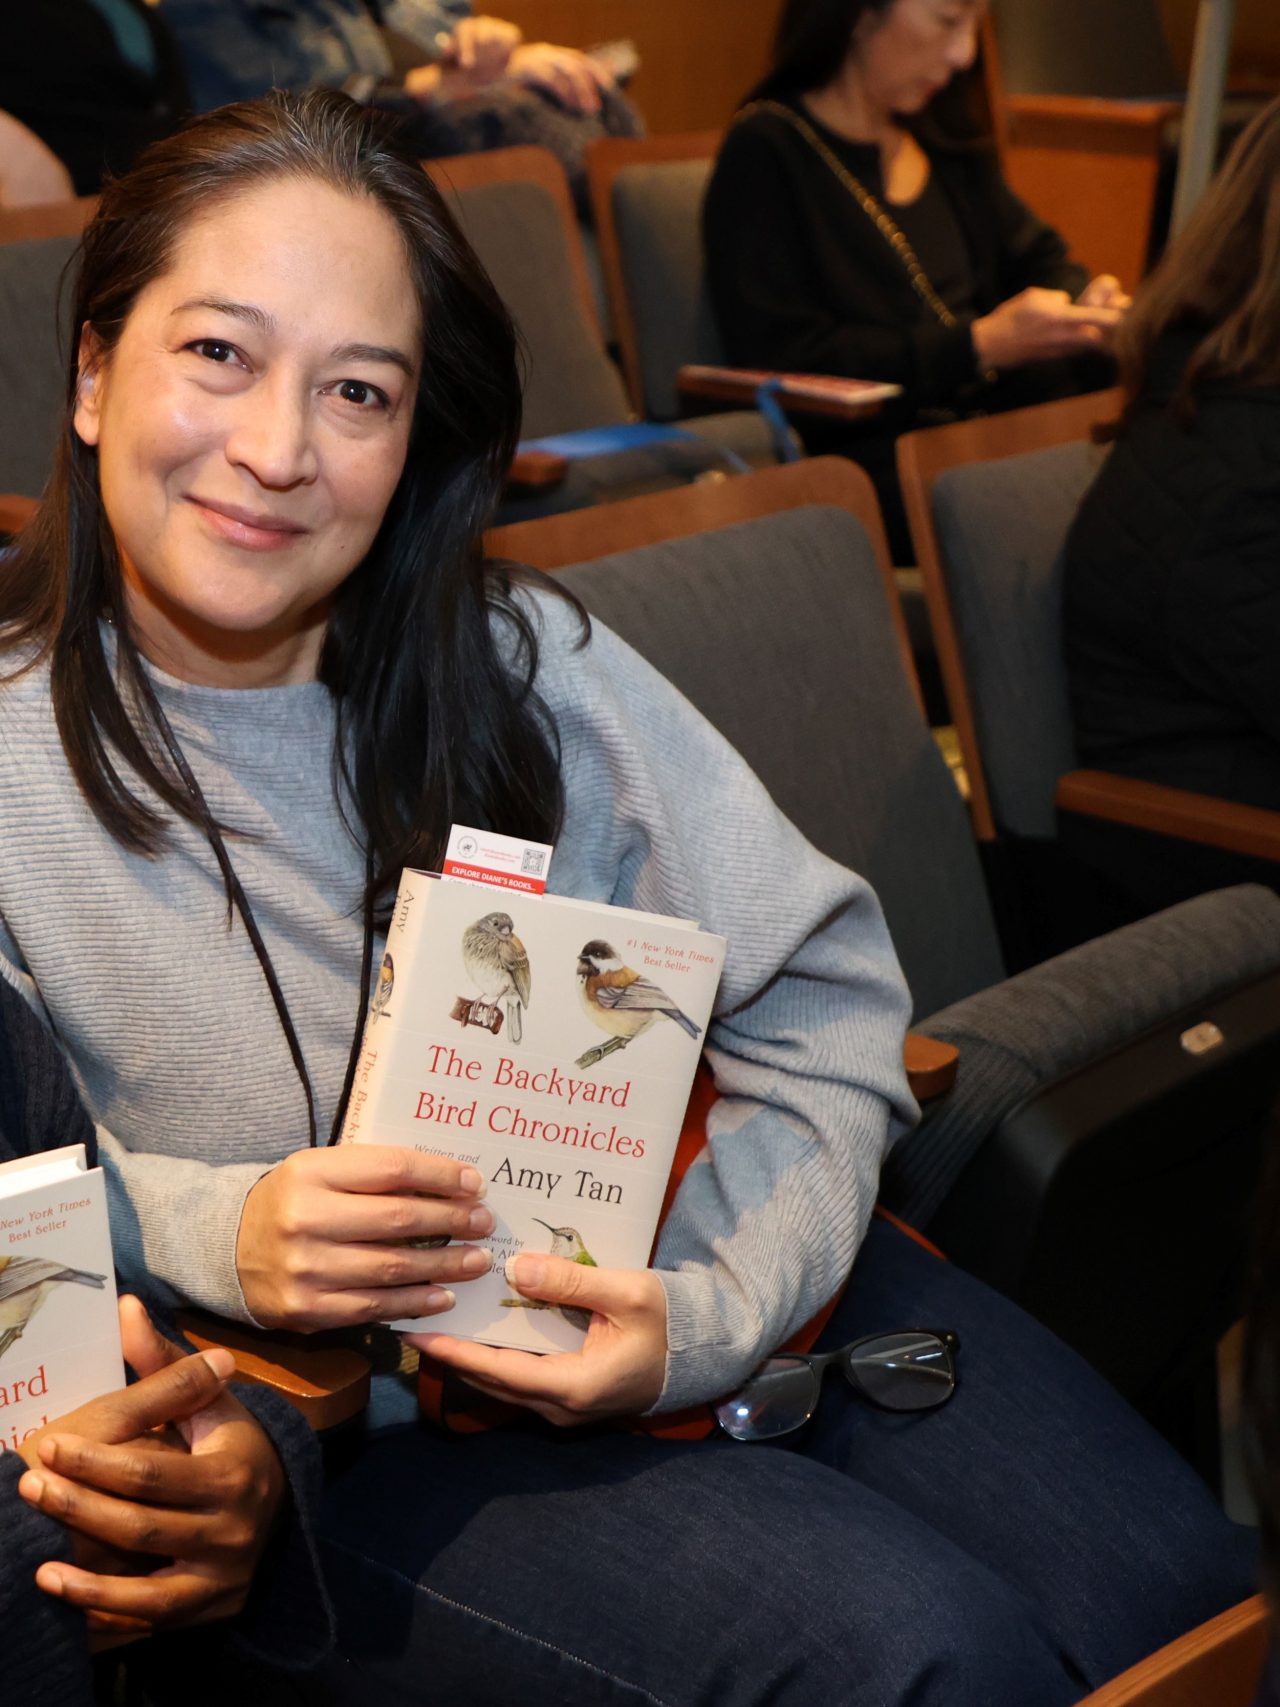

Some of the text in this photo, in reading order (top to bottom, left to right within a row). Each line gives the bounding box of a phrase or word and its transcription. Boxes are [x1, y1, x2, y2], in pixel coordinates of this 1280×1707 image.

[451, 866, 481, 879] EXPLORE
[481, 872, 508, 885] DIANE'S
[396, 889, 415, 933] Amy
[627, 939, 715, 964] #1 New York Times
[643, 955, 692, 973] Best Seller
[361, 1051, 378, 1083] The
[428, 1043, 632, 1109] The Backyard
[413, 1090, 646, 1159] Bird Chronicles
[457, 1152, 481, 1164] and
[491, 1156, 624, 1205] Amy Tan
[0, 1216, 25, 1230] New
[28, 1207, 54, 1222] York
[58, 1197, 92, 1213] Times
[8, 1219, 68, 1243] Best Seller
[515, 1237, 525, 1248] by
